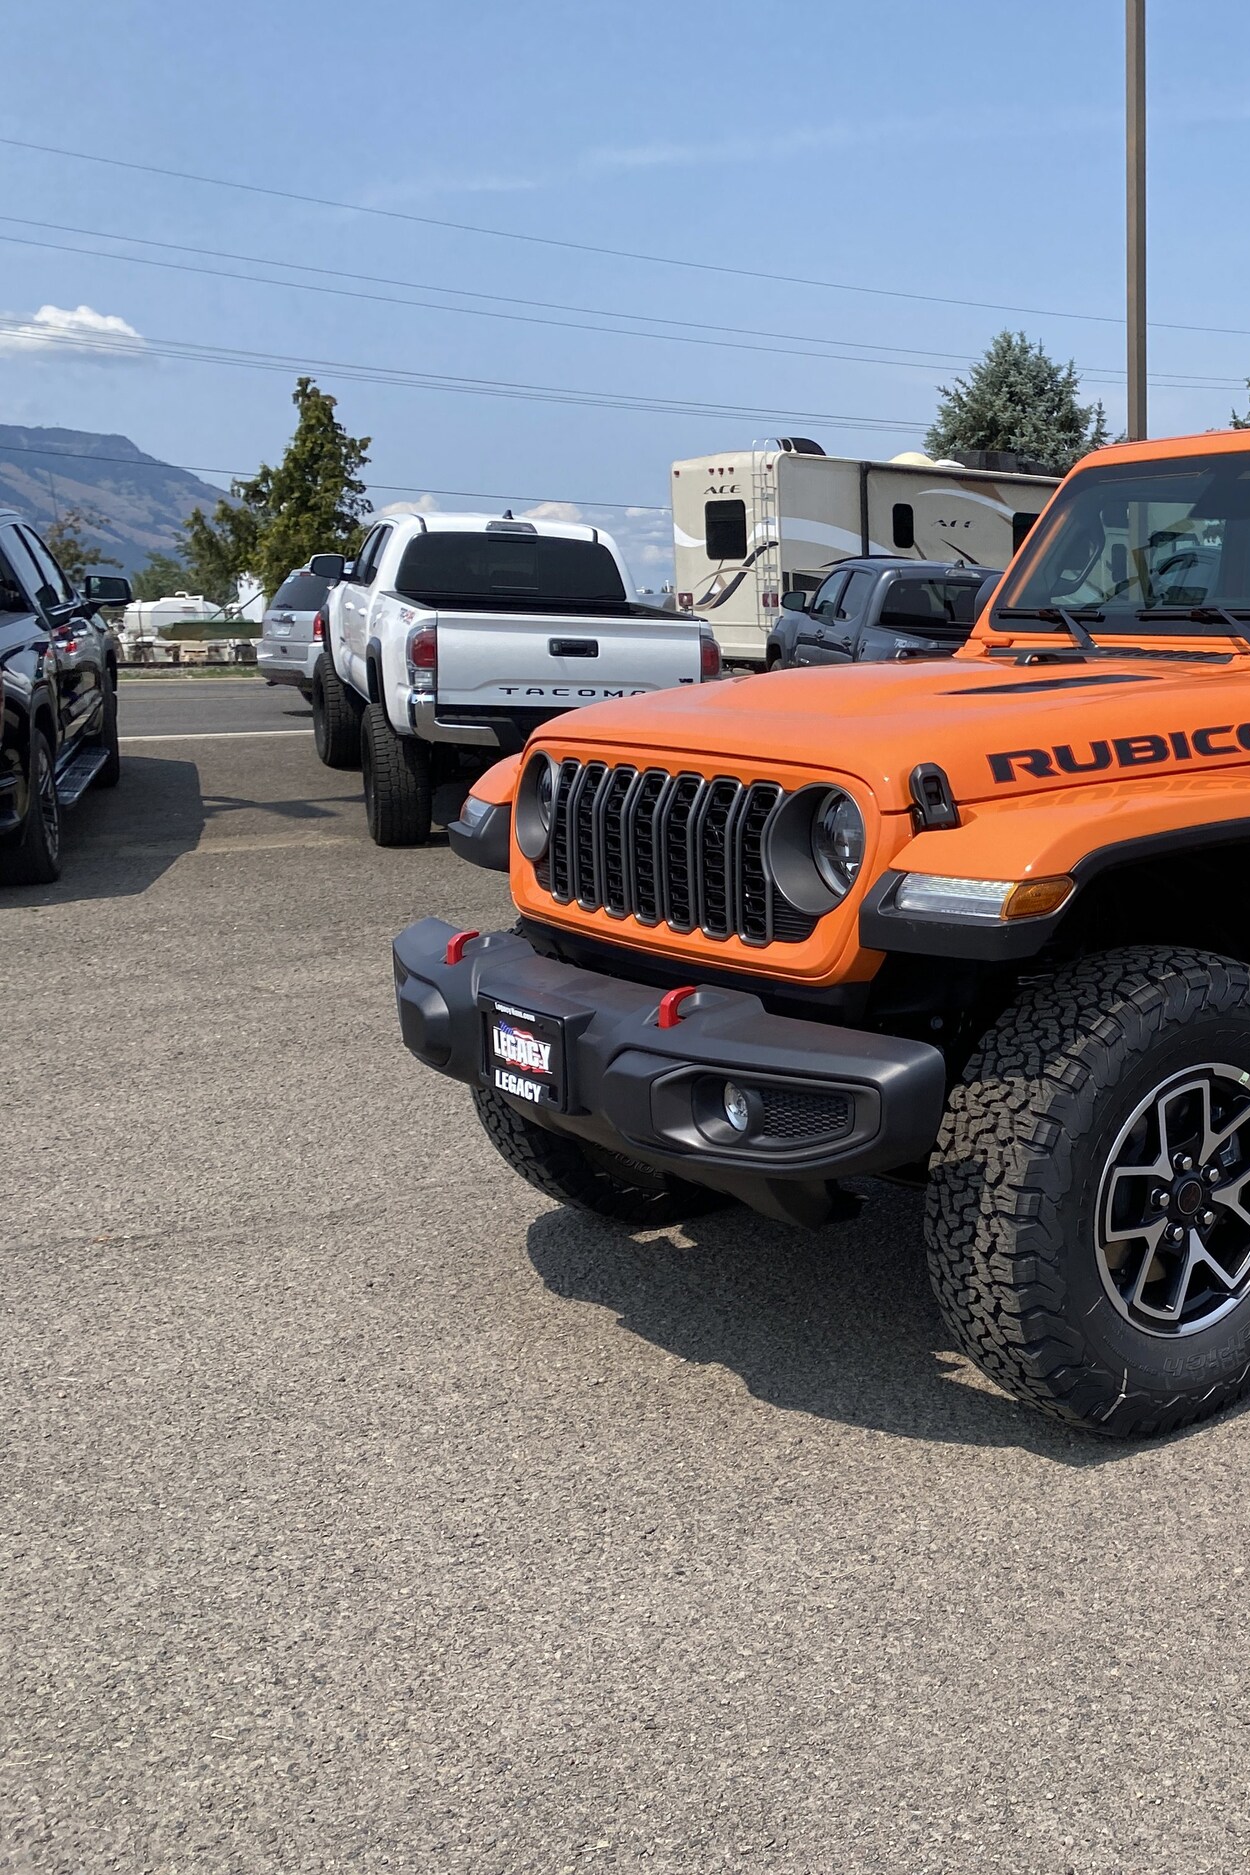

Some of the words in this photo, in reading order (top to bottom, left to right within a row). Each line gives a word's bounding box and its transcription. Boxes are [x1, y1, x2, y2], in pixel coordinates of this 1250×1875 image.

[704, 485, 741, 494] ACE
[493, 1028, 551, 1071] LEGACY
[495, 1069, 541, 1103] LEGACY
